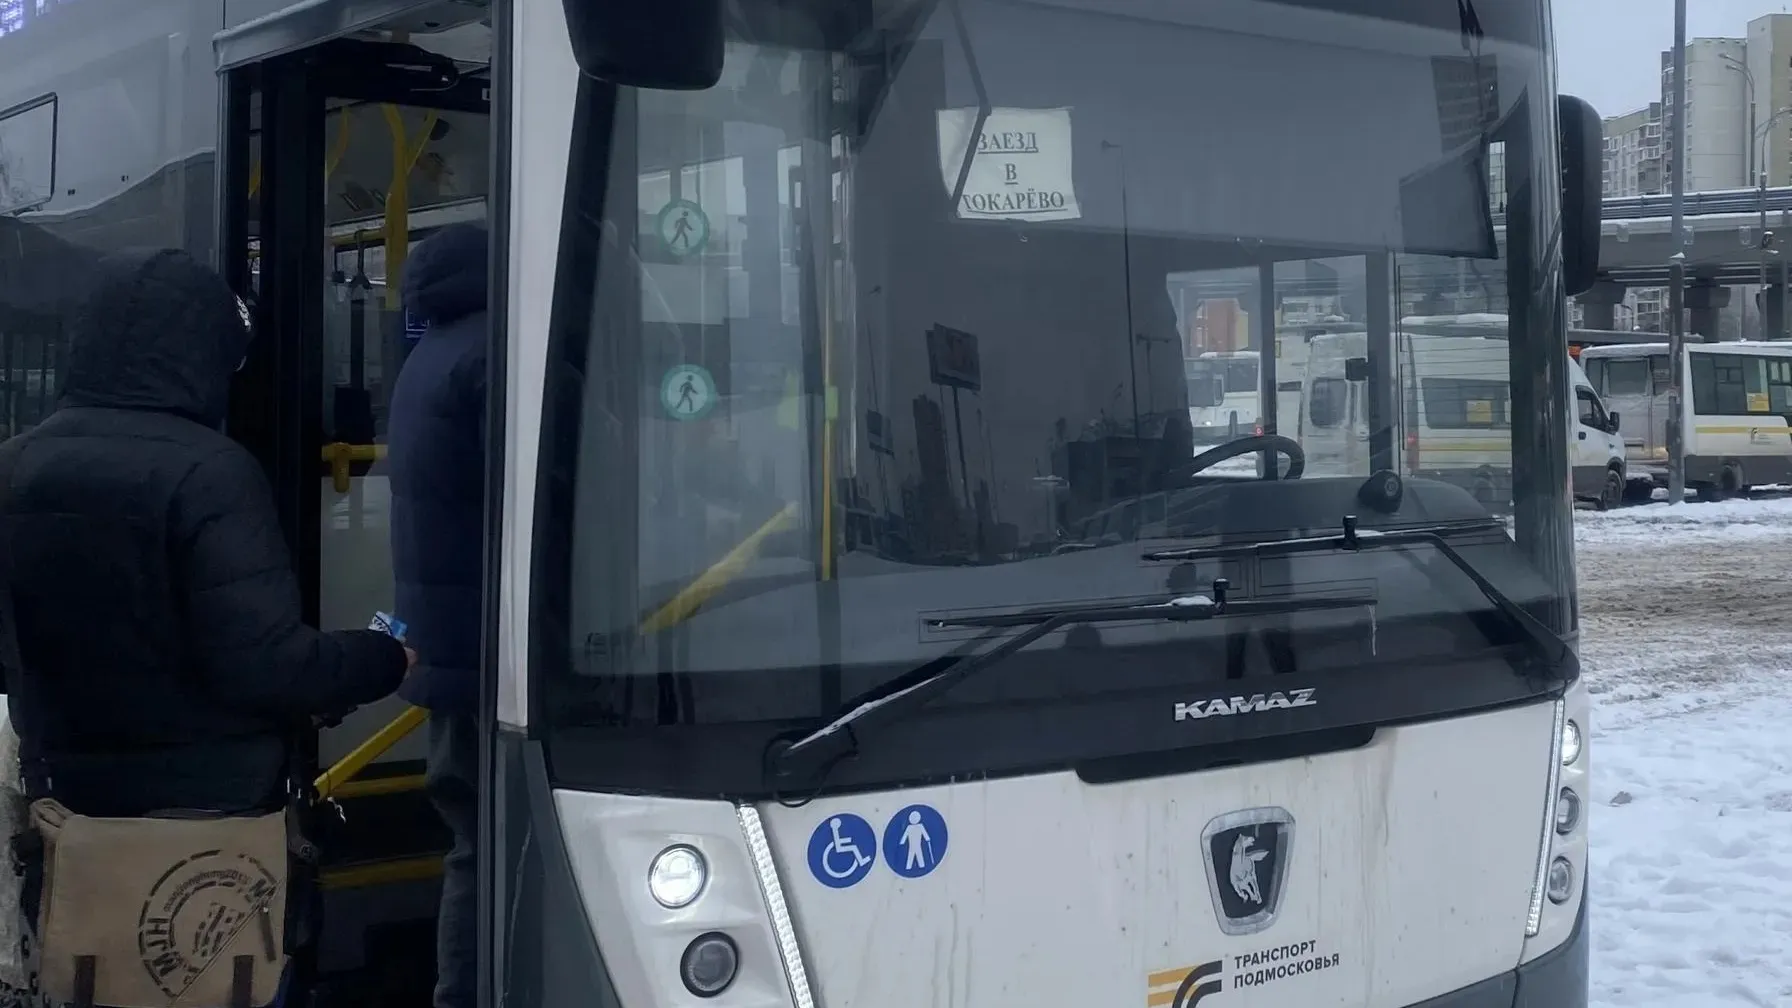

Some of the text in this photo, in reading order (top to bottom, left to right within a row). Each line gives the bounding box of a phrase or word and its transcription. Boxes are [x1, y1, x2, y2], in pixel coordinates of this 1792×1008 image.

[977, 132, 1038, 152] ЗАЕЗД
[1005, 163, 1017, 180] В
[1174, 687, 1317, 721] KAMAZ
[1234, 940, 1317, 969] ТРАНСПОРТ
[1234, 953, 1340, 989] ПОДМОСКОВЬЯ
